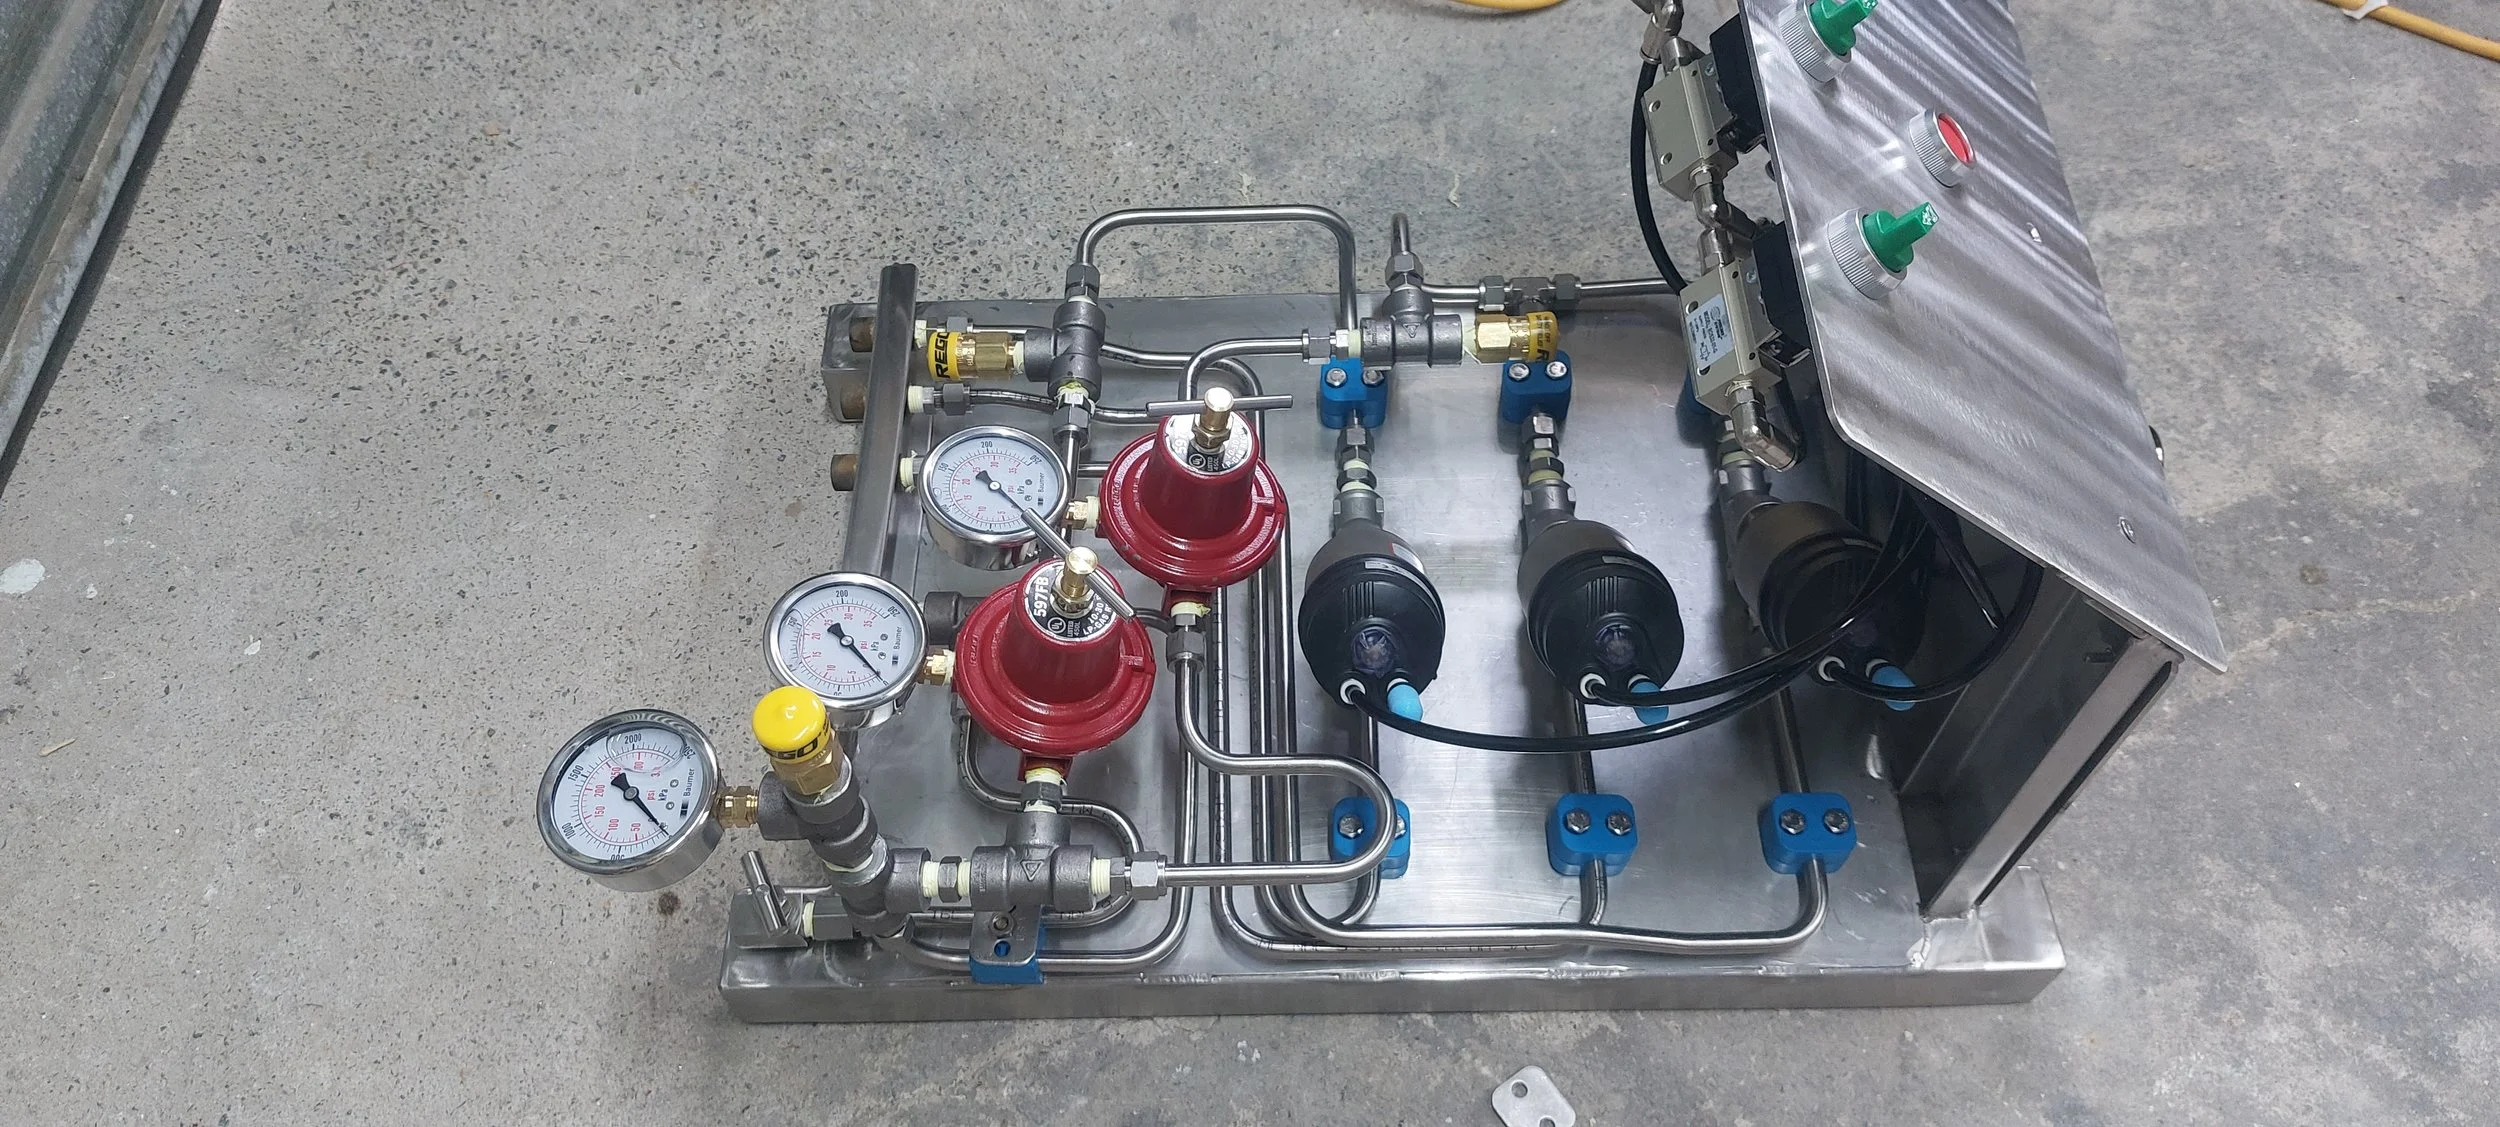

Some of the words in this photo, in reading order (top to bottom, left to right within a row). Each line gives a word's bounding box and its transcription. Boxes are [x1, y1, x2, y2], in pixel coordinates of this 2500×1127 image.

[1030, 455, 1042, 464] 250
[938, 462, 948, 472] 150
[1034, 576, 1048, 617] 597FB
[888, 606, 900, 618] 250
[1083, 614, 1110, 635] LP-GAS
[894, 626, 902, 650] Baumer
[624, 734, 642, 744] 2000
[568, 765, 584, 781] 1500
[683, 768, 695, 796] Baumer
[594, 784, 605, 797] 200
[659, 789, 668, 801] kPa
[594, 806, 605, 818] 150
[608, 818, 619, 830] 100
[631, 823, 640, 832] 50
[562, 822, 576, 839] 1000
